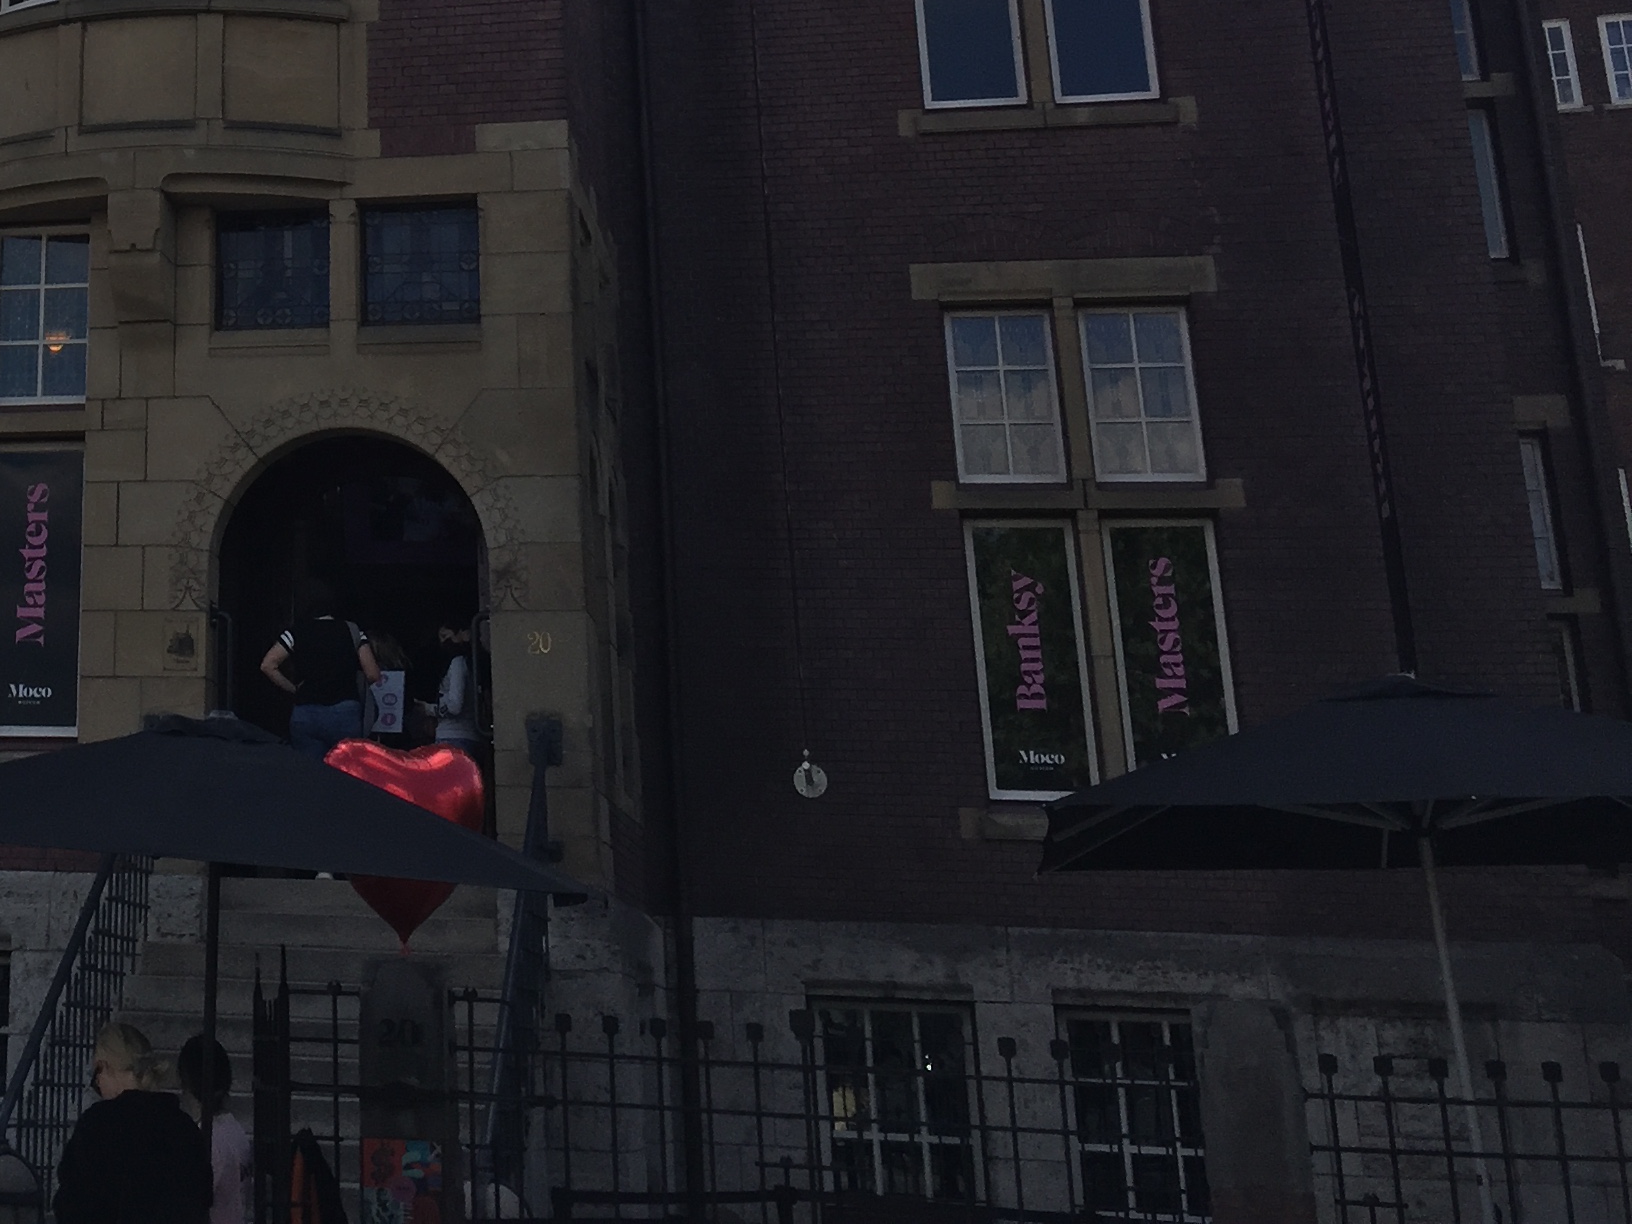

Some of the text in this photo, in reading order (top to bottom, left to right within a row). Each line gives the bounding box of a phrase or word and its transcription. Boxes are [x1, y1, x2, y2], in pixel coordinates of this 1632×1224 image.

[15, 482, 50, 647] Masters
[527, 631, 552, 654] 20
[1006, 569, 1048, 712] Banksy
[1148, 557, 1190, 716] Masters
[7, 683, 52, 698] Moco
[1018, 750, 1066, 765] Moco
